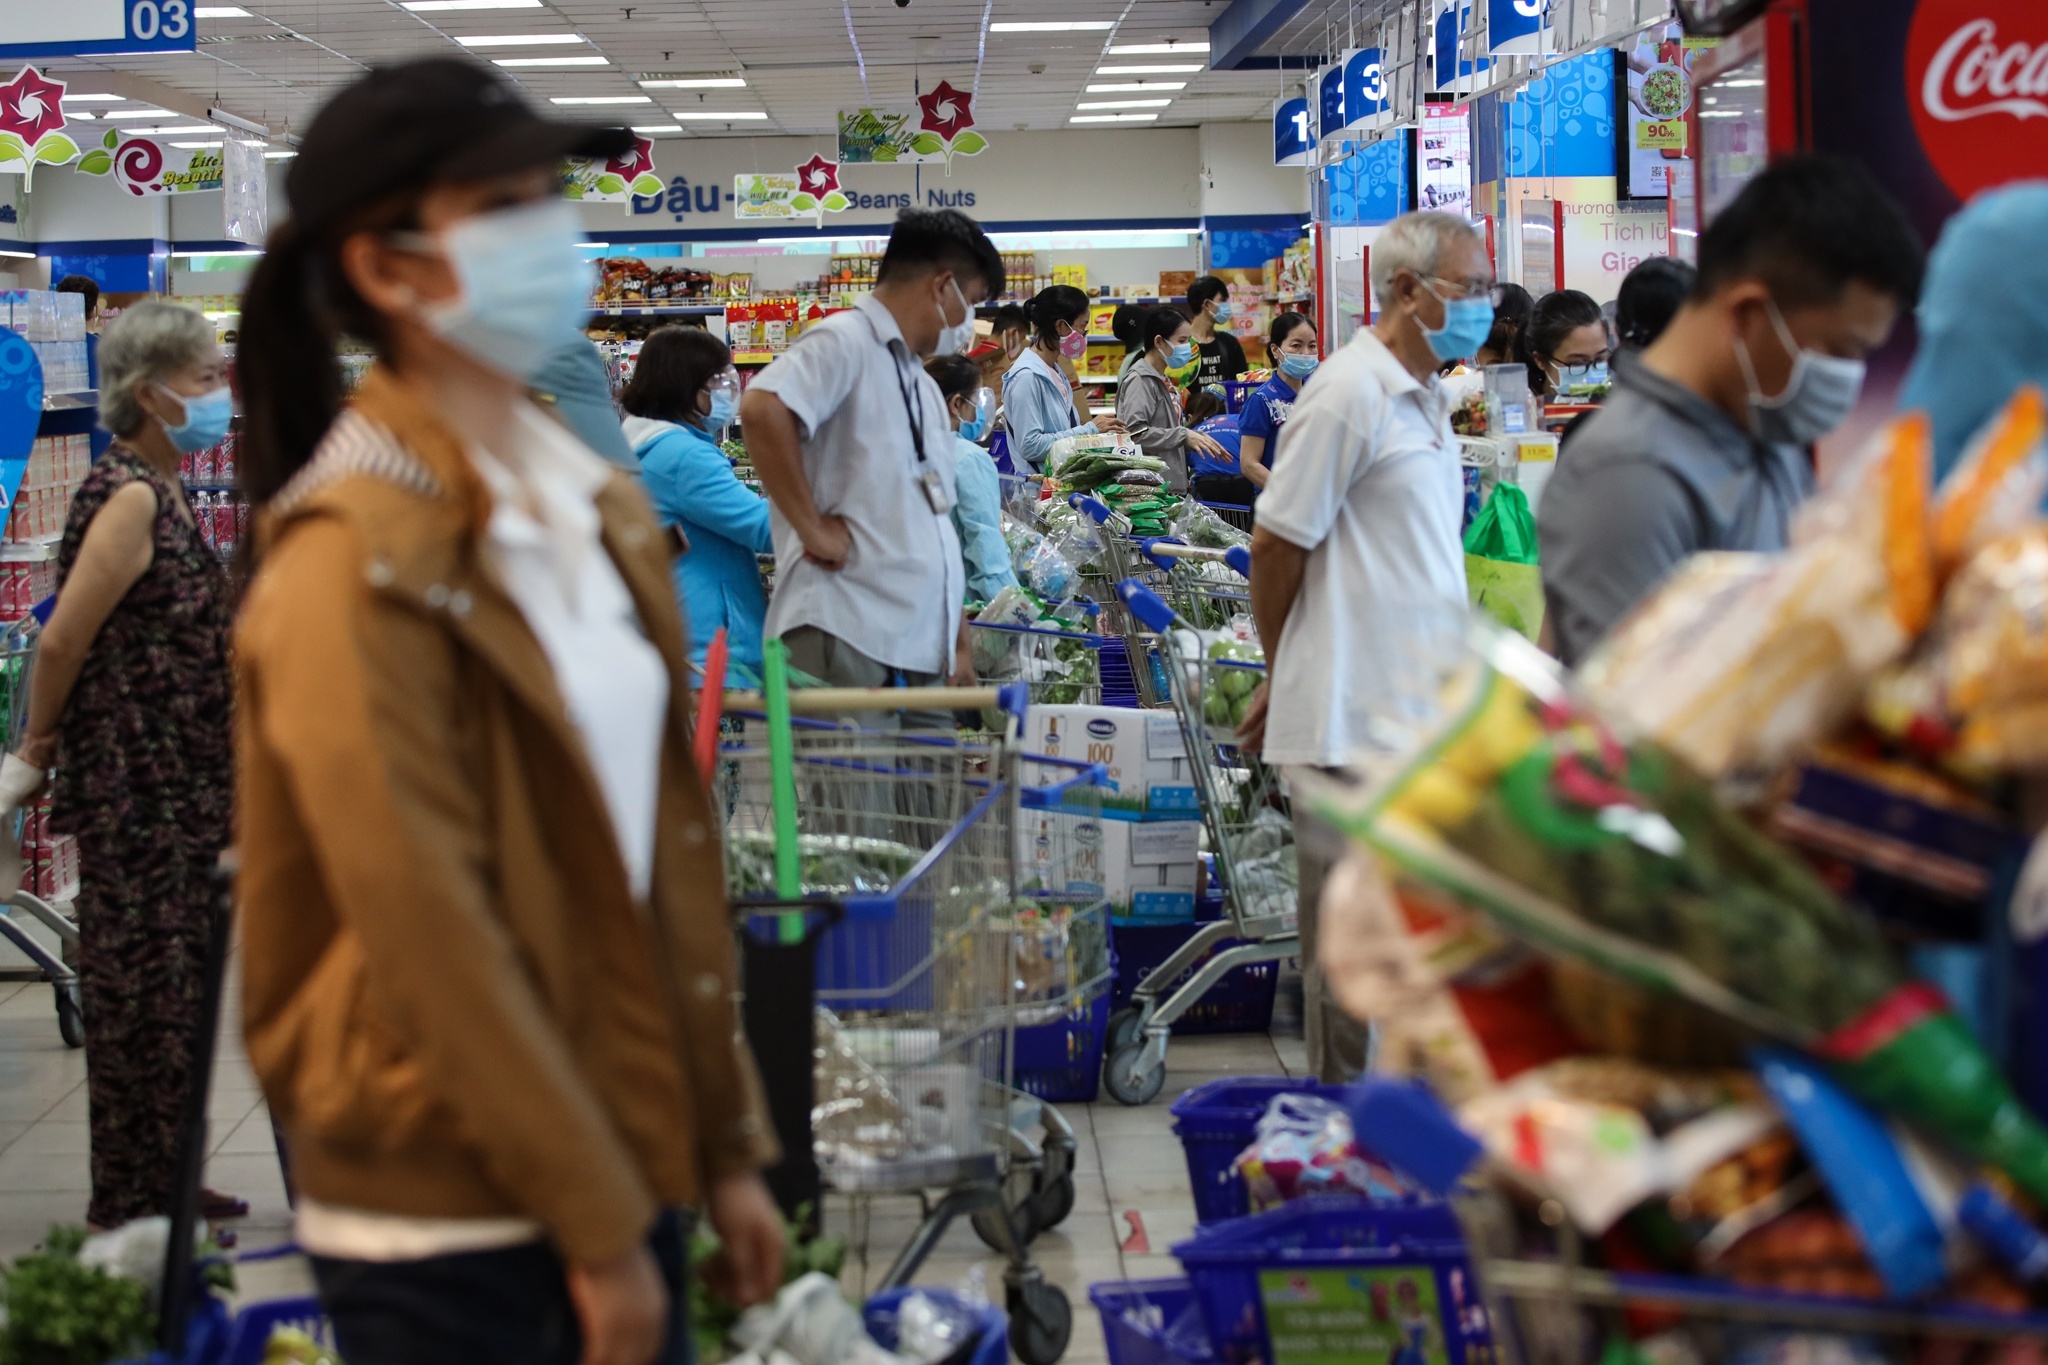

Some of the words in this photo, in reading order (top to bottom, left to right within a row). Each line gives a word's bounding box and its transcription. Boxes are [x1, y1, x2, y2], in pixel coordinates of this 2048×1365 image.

[132, 0, 189, 40] 03
[1363, 63, 1387, 100] 3
[843, 114, 889, 136] Happy
[1291, 111, 1307, 142] 1
[1647, 124, 1675, 138] 90%
[191, 155, 218, 169] Life
[844, 190, 911, 209] Beans
[928, 189, 976, 208] Nuts
[1600, 222, 1643, 241] Tích
[1652, 222, 1667, 240] lũ
[1601, 251, 1641, 272] Gia
[1202, 356, 1221, 365] WHAT
[1209, 366, 1216, 374] IS
[1199, 375, 1223, 384] NORMA
